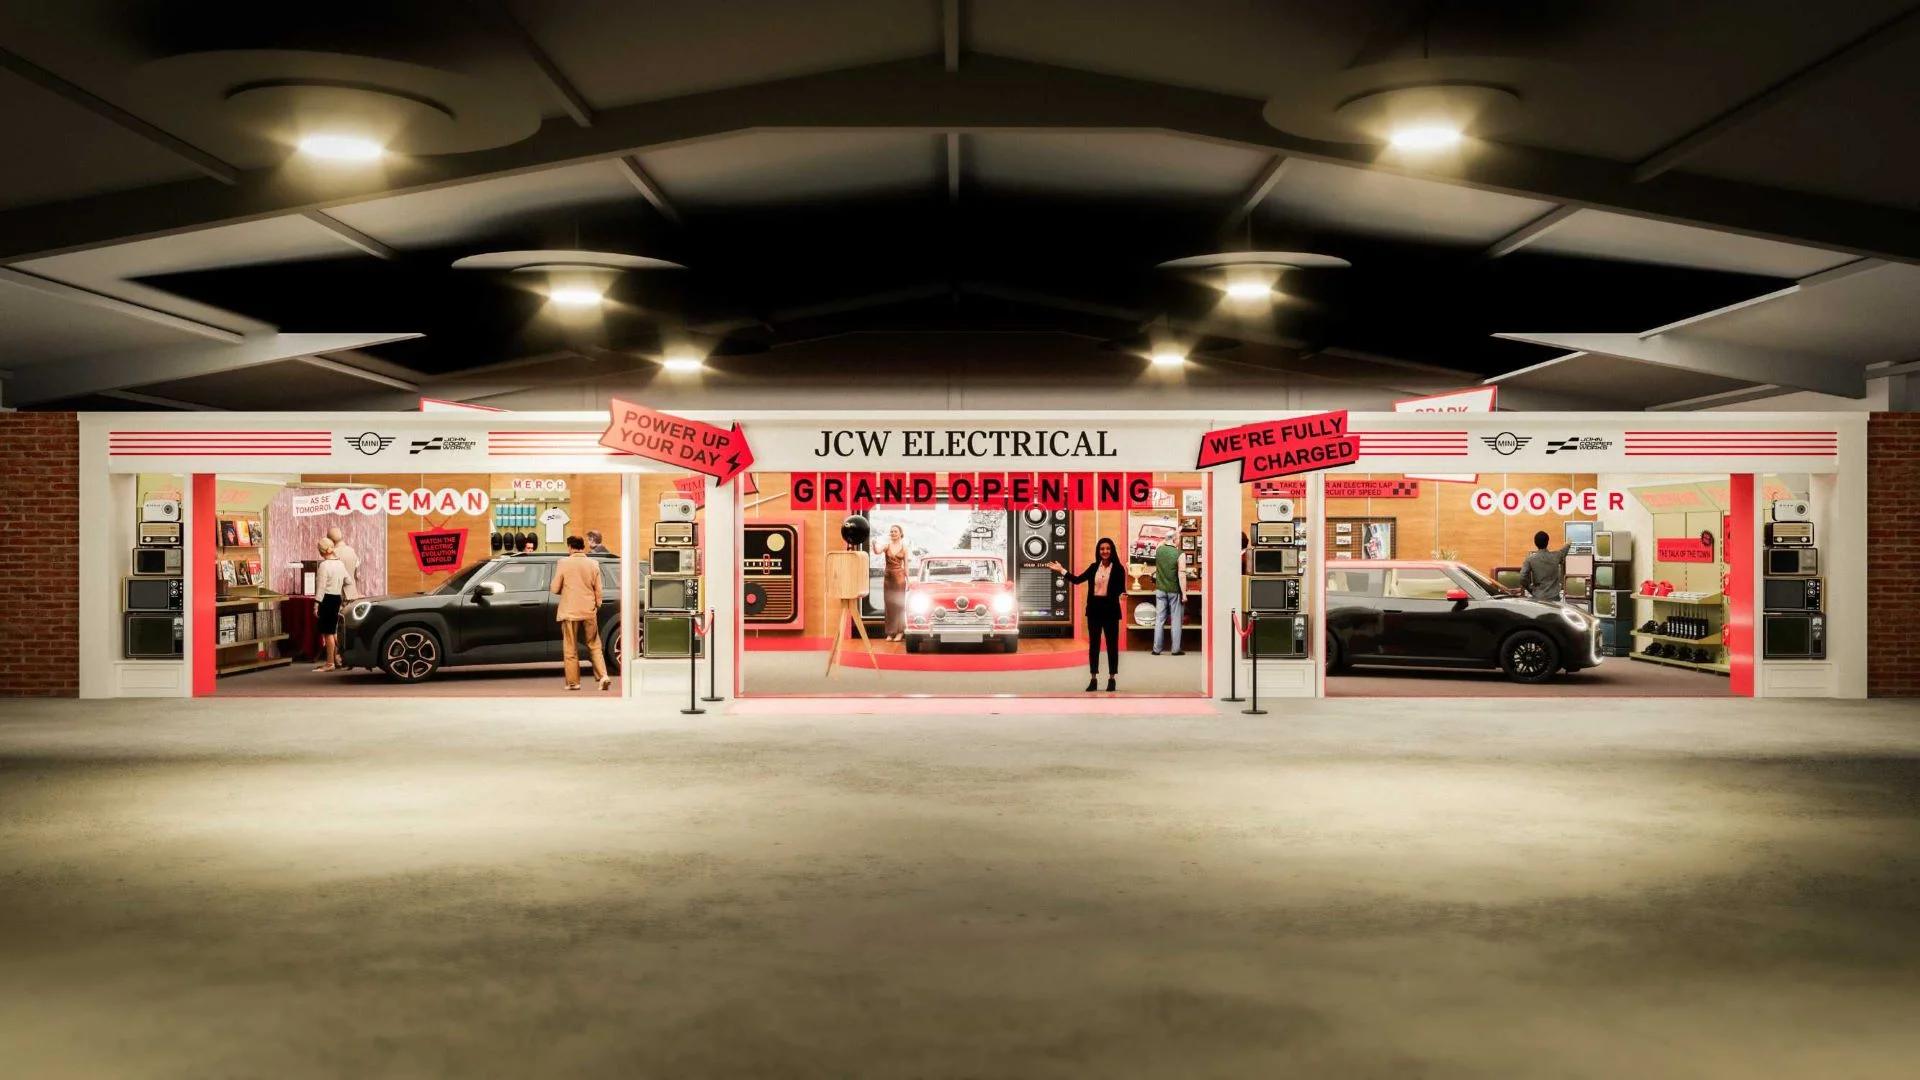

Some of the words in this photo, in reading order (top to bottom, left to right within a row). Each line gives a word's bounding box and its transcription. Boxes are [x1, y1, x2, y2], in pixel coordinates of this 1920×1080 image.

[624, 410, 697, 443] POWER
[702, 431, 730, 450] UP
[1210, 429, 1276, 454] WE'RE
[1281, 417, 1343, 442] FULLY
[620, 427, 674, 455] YOUR
[679, 445, 721, 467] DAY
[814, 430, 892, 457] JCW
[902, 430, 1118, 457] ELECTRICAL
[1253, 441, 1353, 472] CHARGED
[513, 480, 564, 489] MERCH
[794, 478, 933, 503] GRAND
[951, 478, 1150, 503] OPENING
[1279, 481, 1297, 489] TAKE
[1332, 481, 1342, 489] AN
[1343, 481, 1377, 489] ELECTRIC
[1378, 481, 1393, 489] LAP
[310, 496, 320, 505] AS
[320, 495, 331, 504] SE
[335, 492, 482, 511] ACEMAN
[1476, 492, 1624, 511] COOPER
[420, 537, 442, 545] WATCH
[423, 543, 454, 551] ELECTRIC
[421, 550, 456, 558] EVOLUTION
[426, 556, 452, 564] UNFOLD
